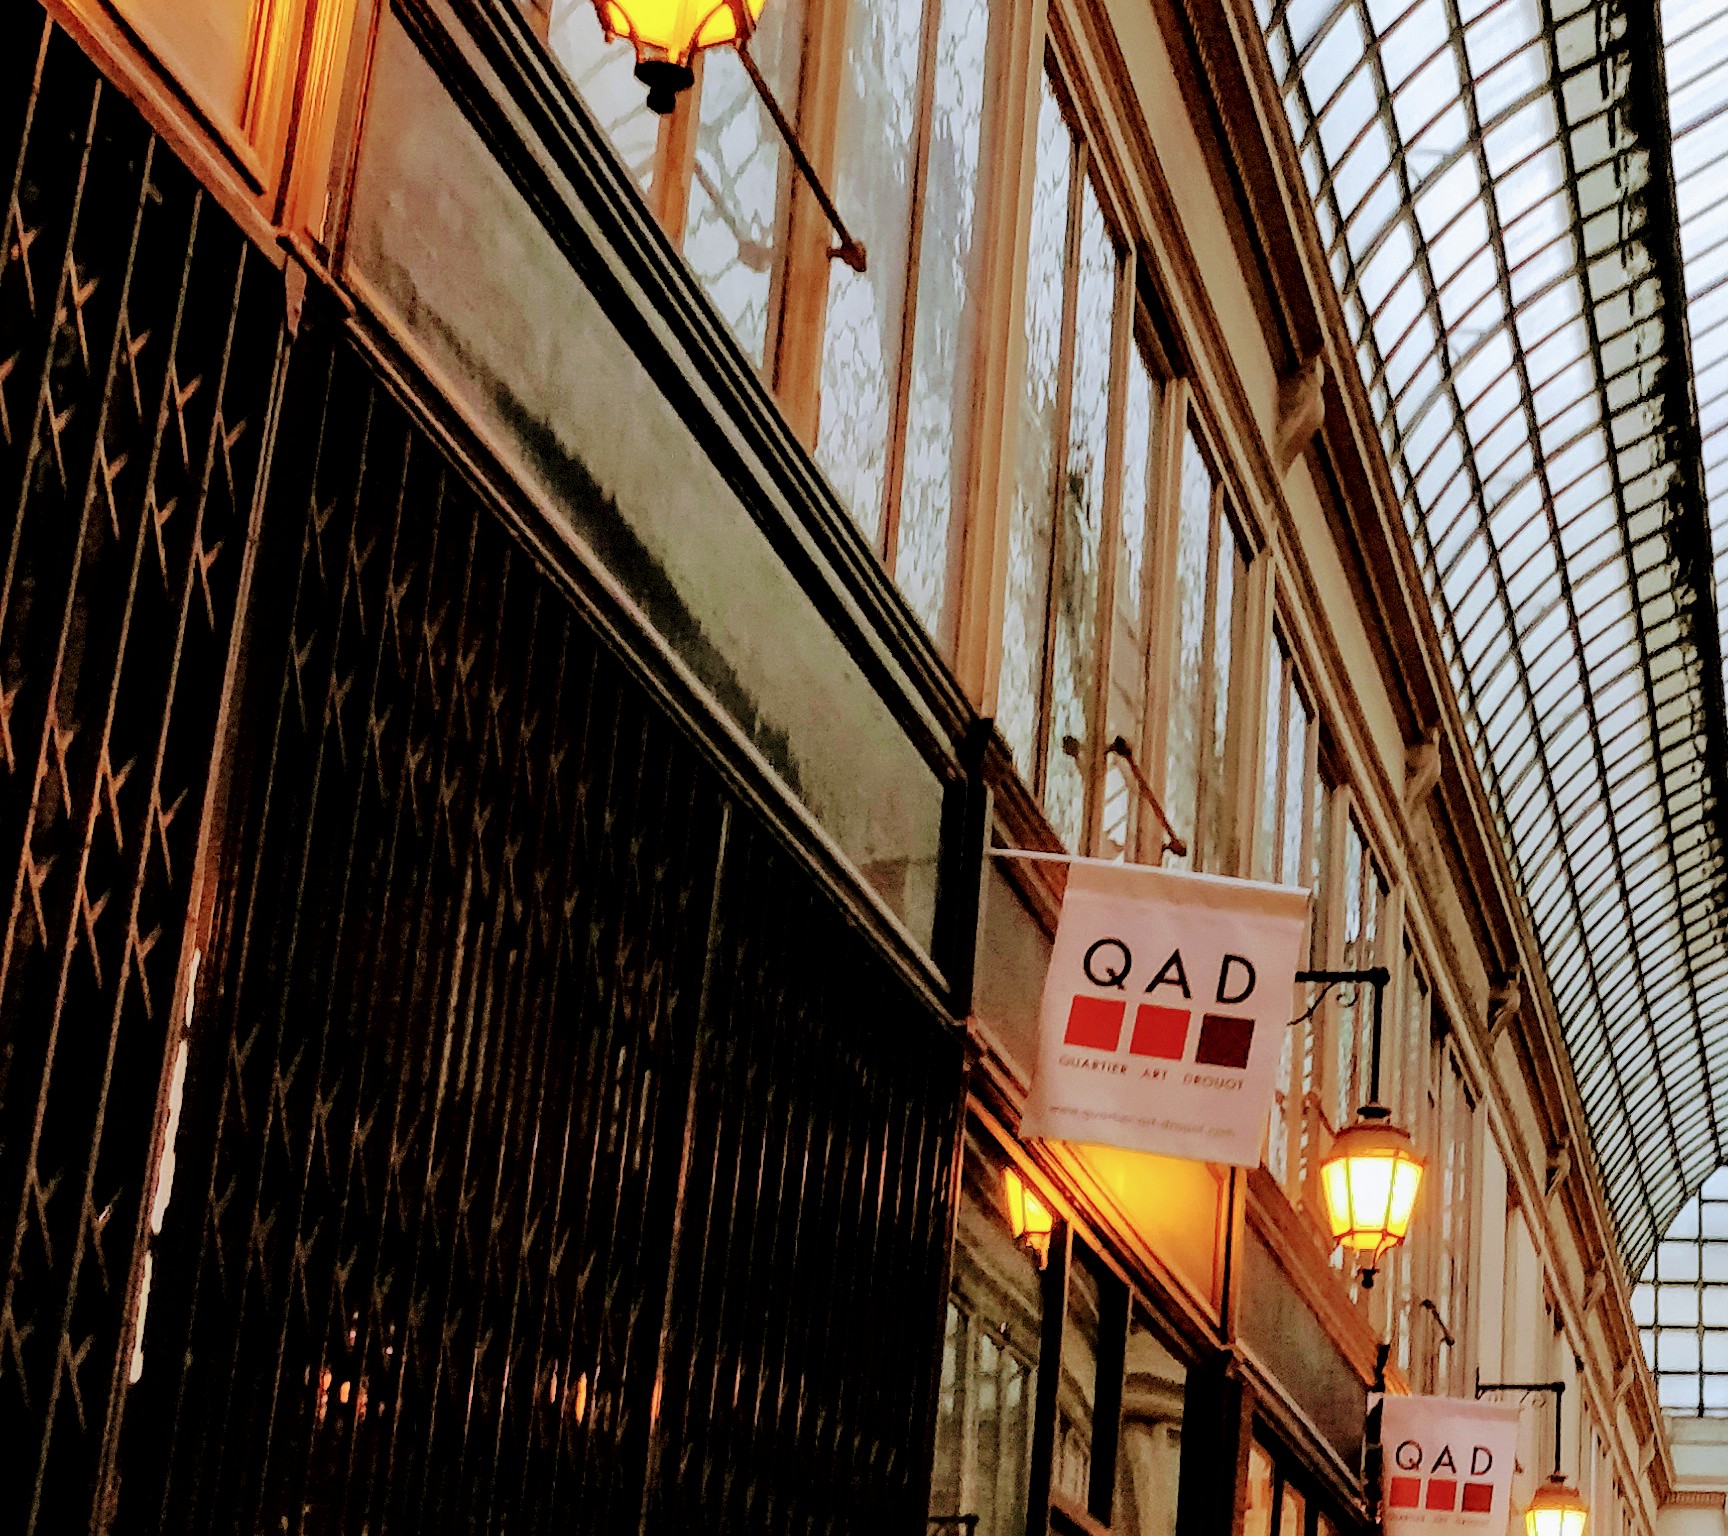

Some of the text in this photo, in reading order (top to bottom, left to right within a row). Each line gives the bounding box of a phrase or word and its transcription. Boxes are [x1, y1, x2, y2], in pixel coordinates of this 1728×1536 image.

[1082, 936, 1257, 1005] QAD
[1058, 1053, 1246, 1092] QUARTIER ART DROUOT
[1395, 1438, 1493, 1476] QAD
